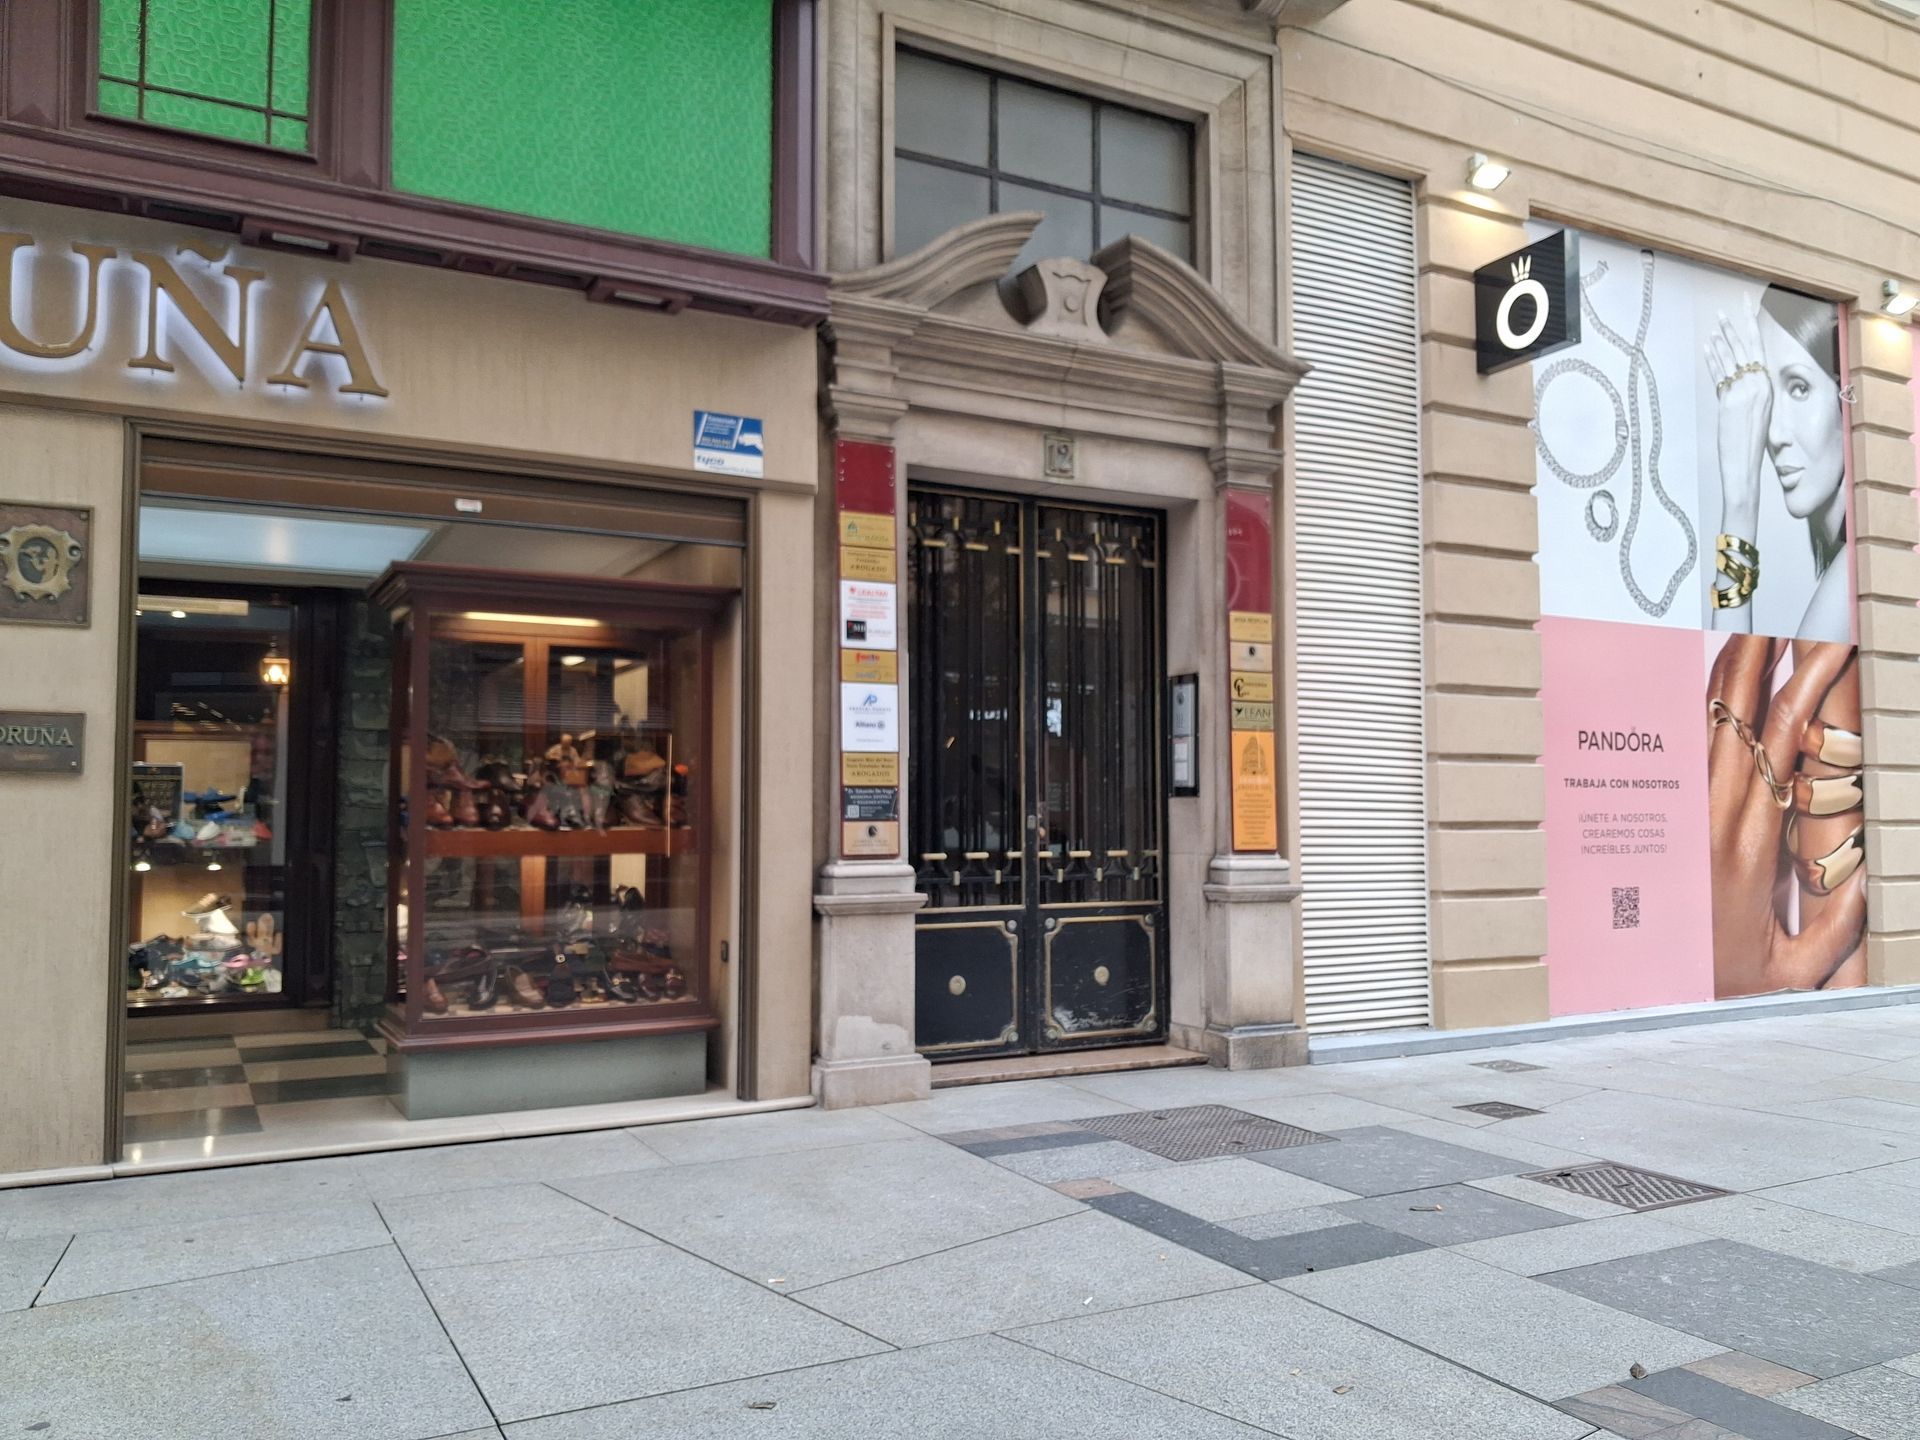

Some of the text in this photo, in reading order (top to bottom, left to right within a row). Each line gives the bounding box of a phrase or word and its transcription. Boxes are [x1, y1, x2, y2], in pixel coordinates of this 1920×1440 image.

[0, 232, 389, 398] UÑA
[1577, 728, 1664, 752] PANDORA
[1563, 777, 1680, 790] TRABAJA CON NOSOTROS
[1611, 814, 1619, 823] A
[1582, 828, 1665, 839] CREAREMOS COSAS
